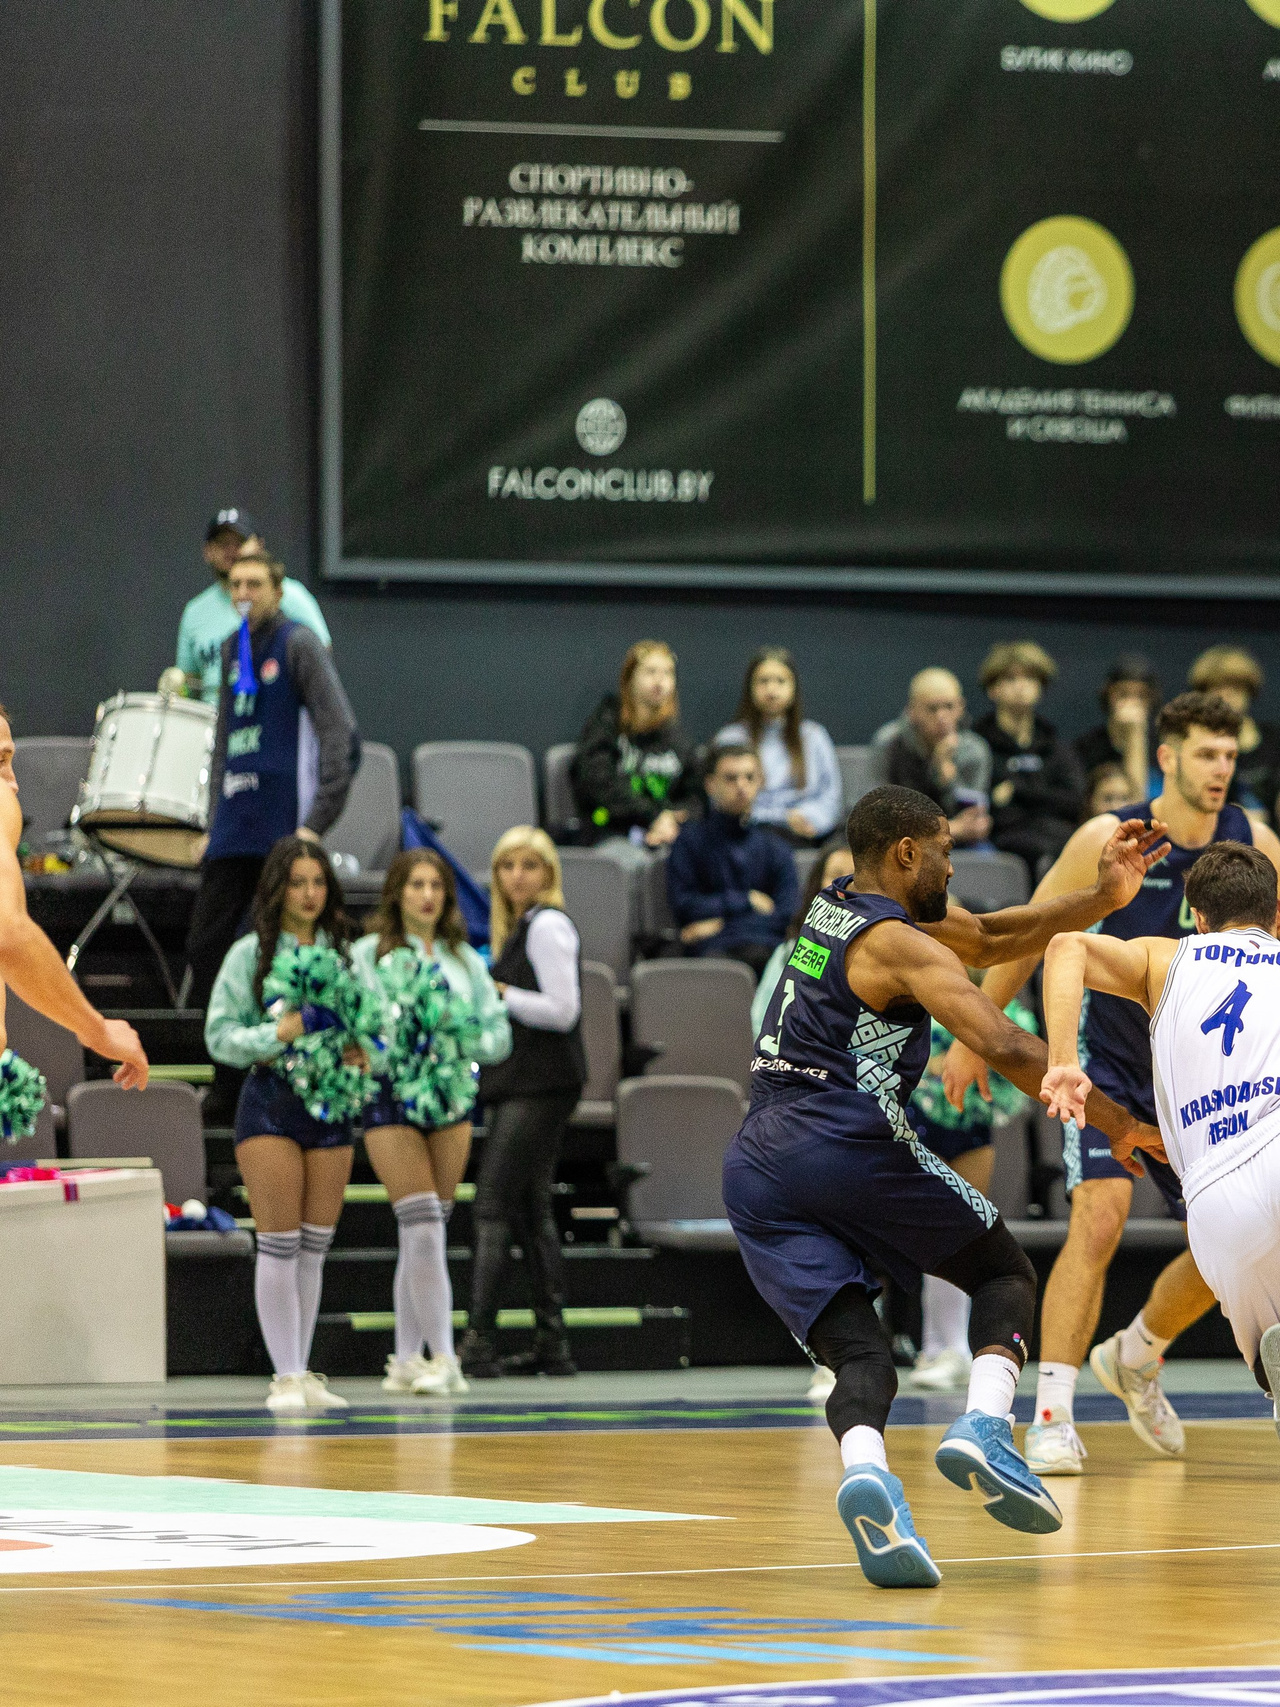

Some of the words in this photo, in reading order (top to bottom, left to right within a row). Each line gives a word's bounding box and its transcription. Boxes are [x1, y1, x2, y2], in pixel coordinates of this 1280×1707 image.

[423, 0, 776, 55] FALCON
[510, 65, 693, 100] CLUB
[520, 233, 684, 268] КОМПЛЕКС
[488, 465, 715, 502] FALCONCLUB.BY
[804, 894, 868, 941] UNGBEMI
[1200, 979, 1253, 1057] 4
